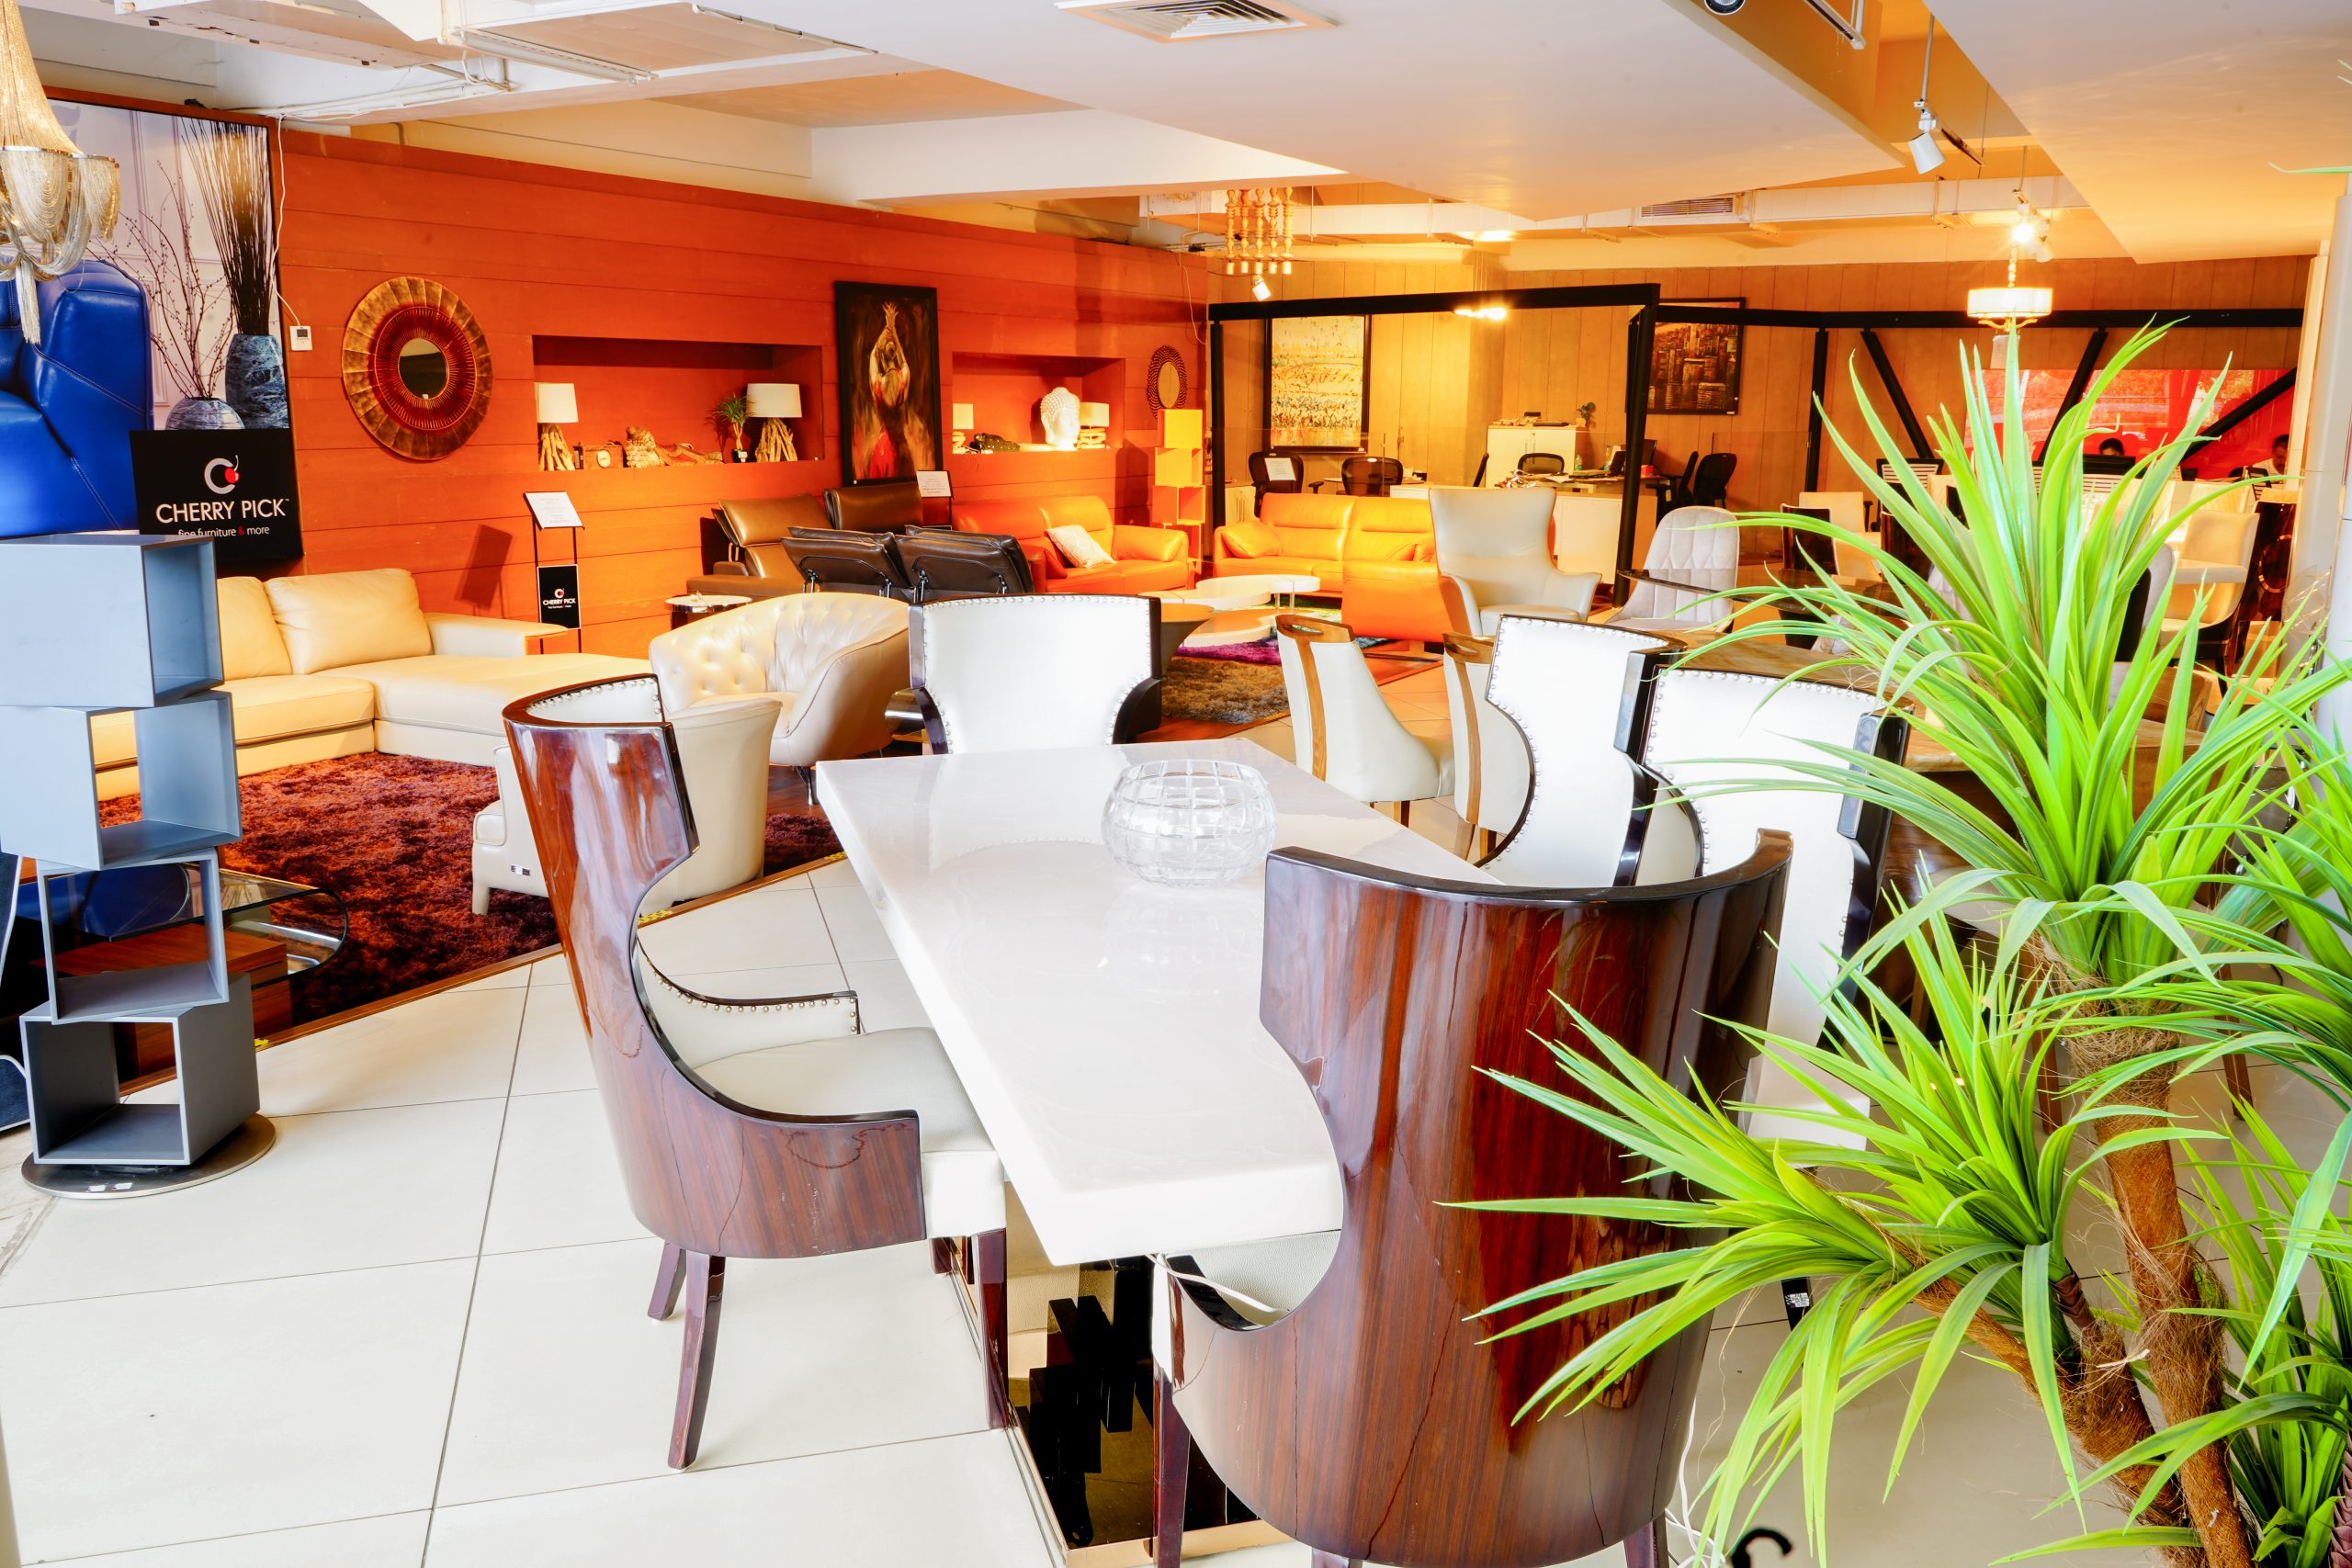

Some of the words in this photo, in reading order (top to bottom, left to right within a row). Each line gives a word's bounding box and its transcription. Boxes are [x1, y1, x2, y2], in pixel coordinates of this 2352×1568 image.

[155, 501, 235, 524] CHERRY
[197, 527, 237, 537] furniture
[246, 526, 270, 536] more
